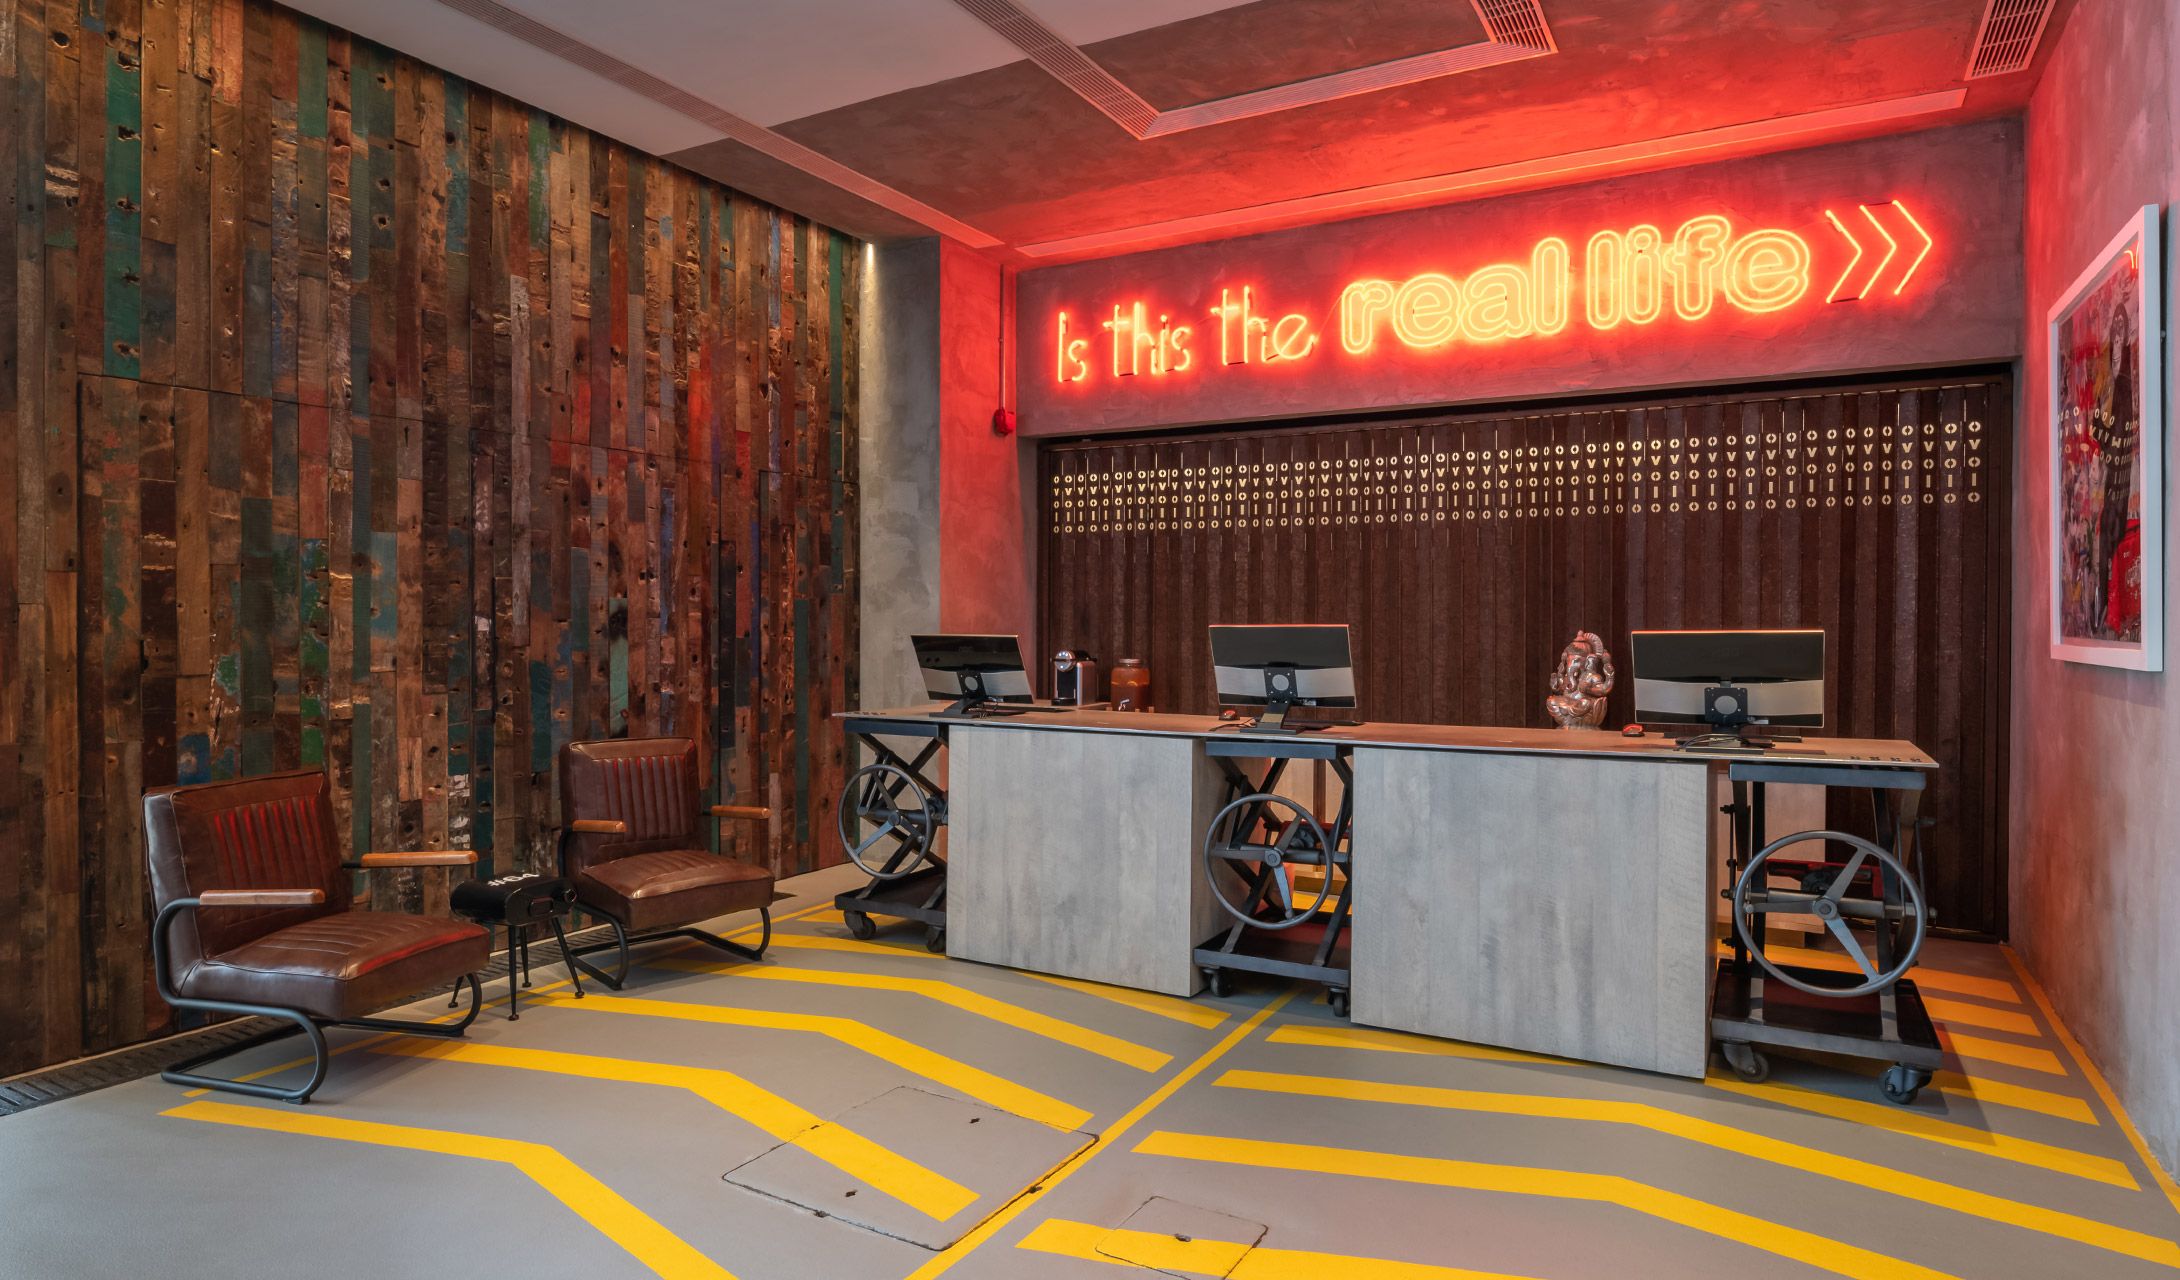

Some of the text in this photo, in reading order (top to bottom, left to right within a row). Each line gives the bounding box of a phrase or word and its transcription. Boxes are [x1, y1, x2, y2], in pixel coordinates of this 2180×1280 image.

[1057, 214, 1809, 383] Is this the real life
